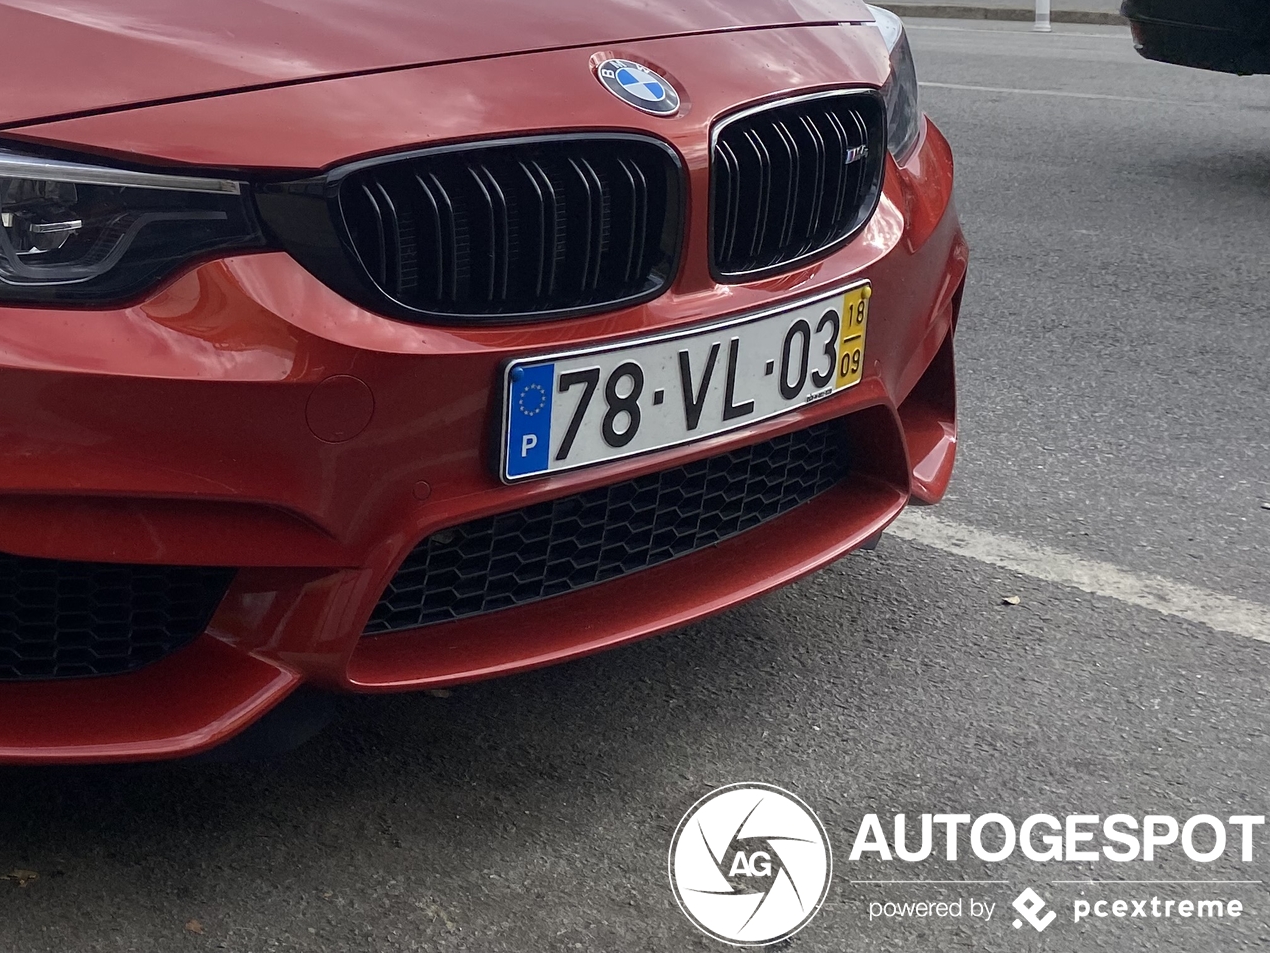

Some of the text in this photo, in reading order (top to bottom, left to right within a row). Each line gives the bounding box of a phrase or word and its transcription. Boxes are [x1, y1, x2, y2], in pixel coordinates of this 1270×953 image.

[849, 300, 865, 328] 18
[840, 348, 861, 378] 09
[521, 434, 538, 458] P
